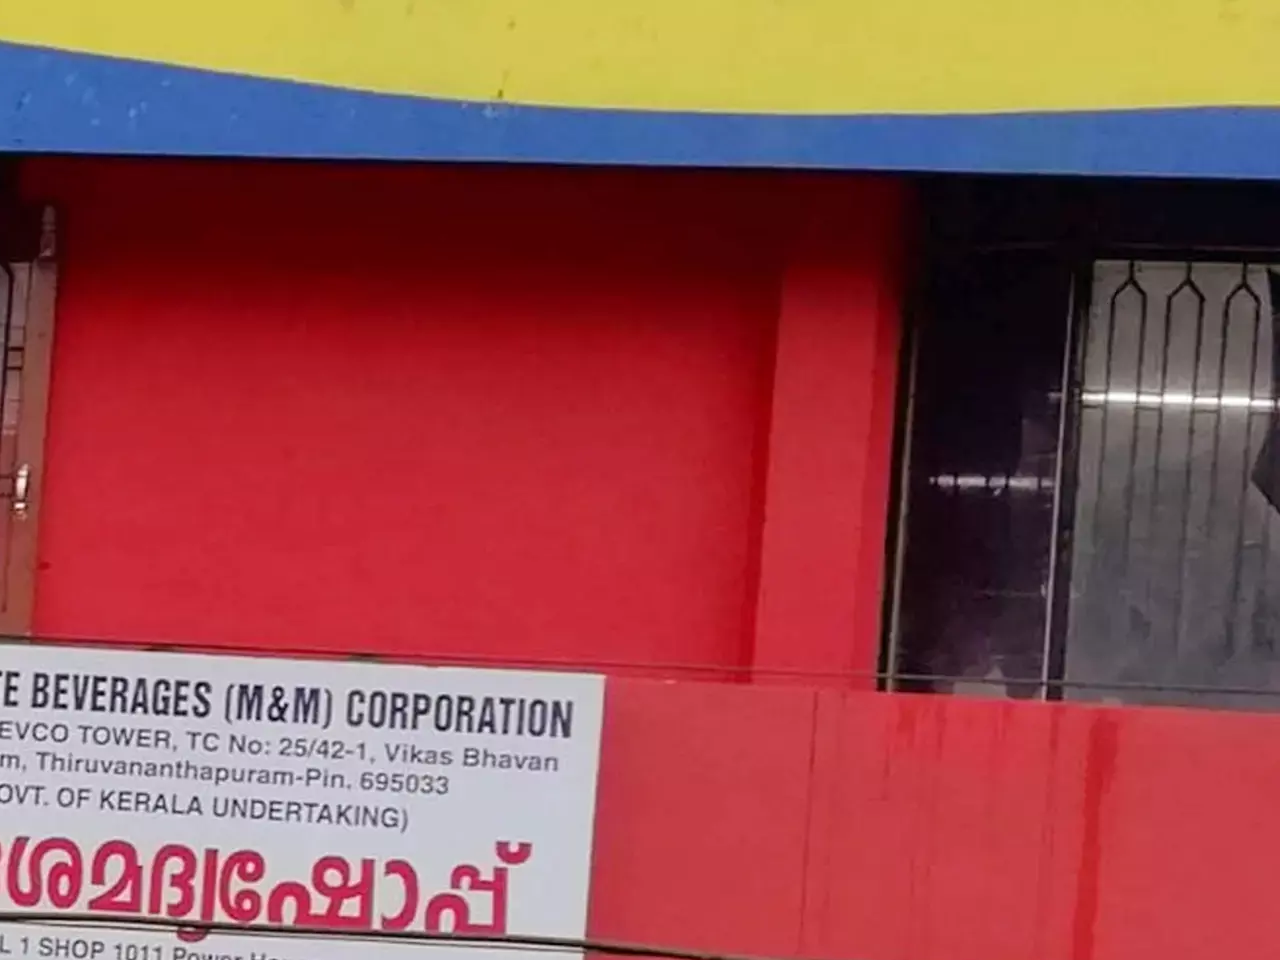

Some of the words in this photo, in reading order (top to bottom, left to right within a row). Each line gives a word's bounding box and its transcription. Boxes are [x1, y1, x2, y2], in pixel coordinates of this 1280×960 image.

[31, 672, 212, 718] BEVERAGES
[224, 683, 333, 729] (M&M)
[345, 690, 574, 738] CORPORATION
[77, 725, 178, 750] TOWER,
[186, 731, 220, 752] TC
[228, 734, 271, 755] No:
[384, 743, 453, 766] Vikas
[461, 747, 559, 772] Bhavan
[359, 771, 449, 795] 695033
[57, 786, 93, 808] OF
[100, 789, 204, 819] KERALA
[213, 797, 409, 834] UNDERTAKING)
[20, 937, 29, 955] 1
[39, 939, 105, 960] SHOP
